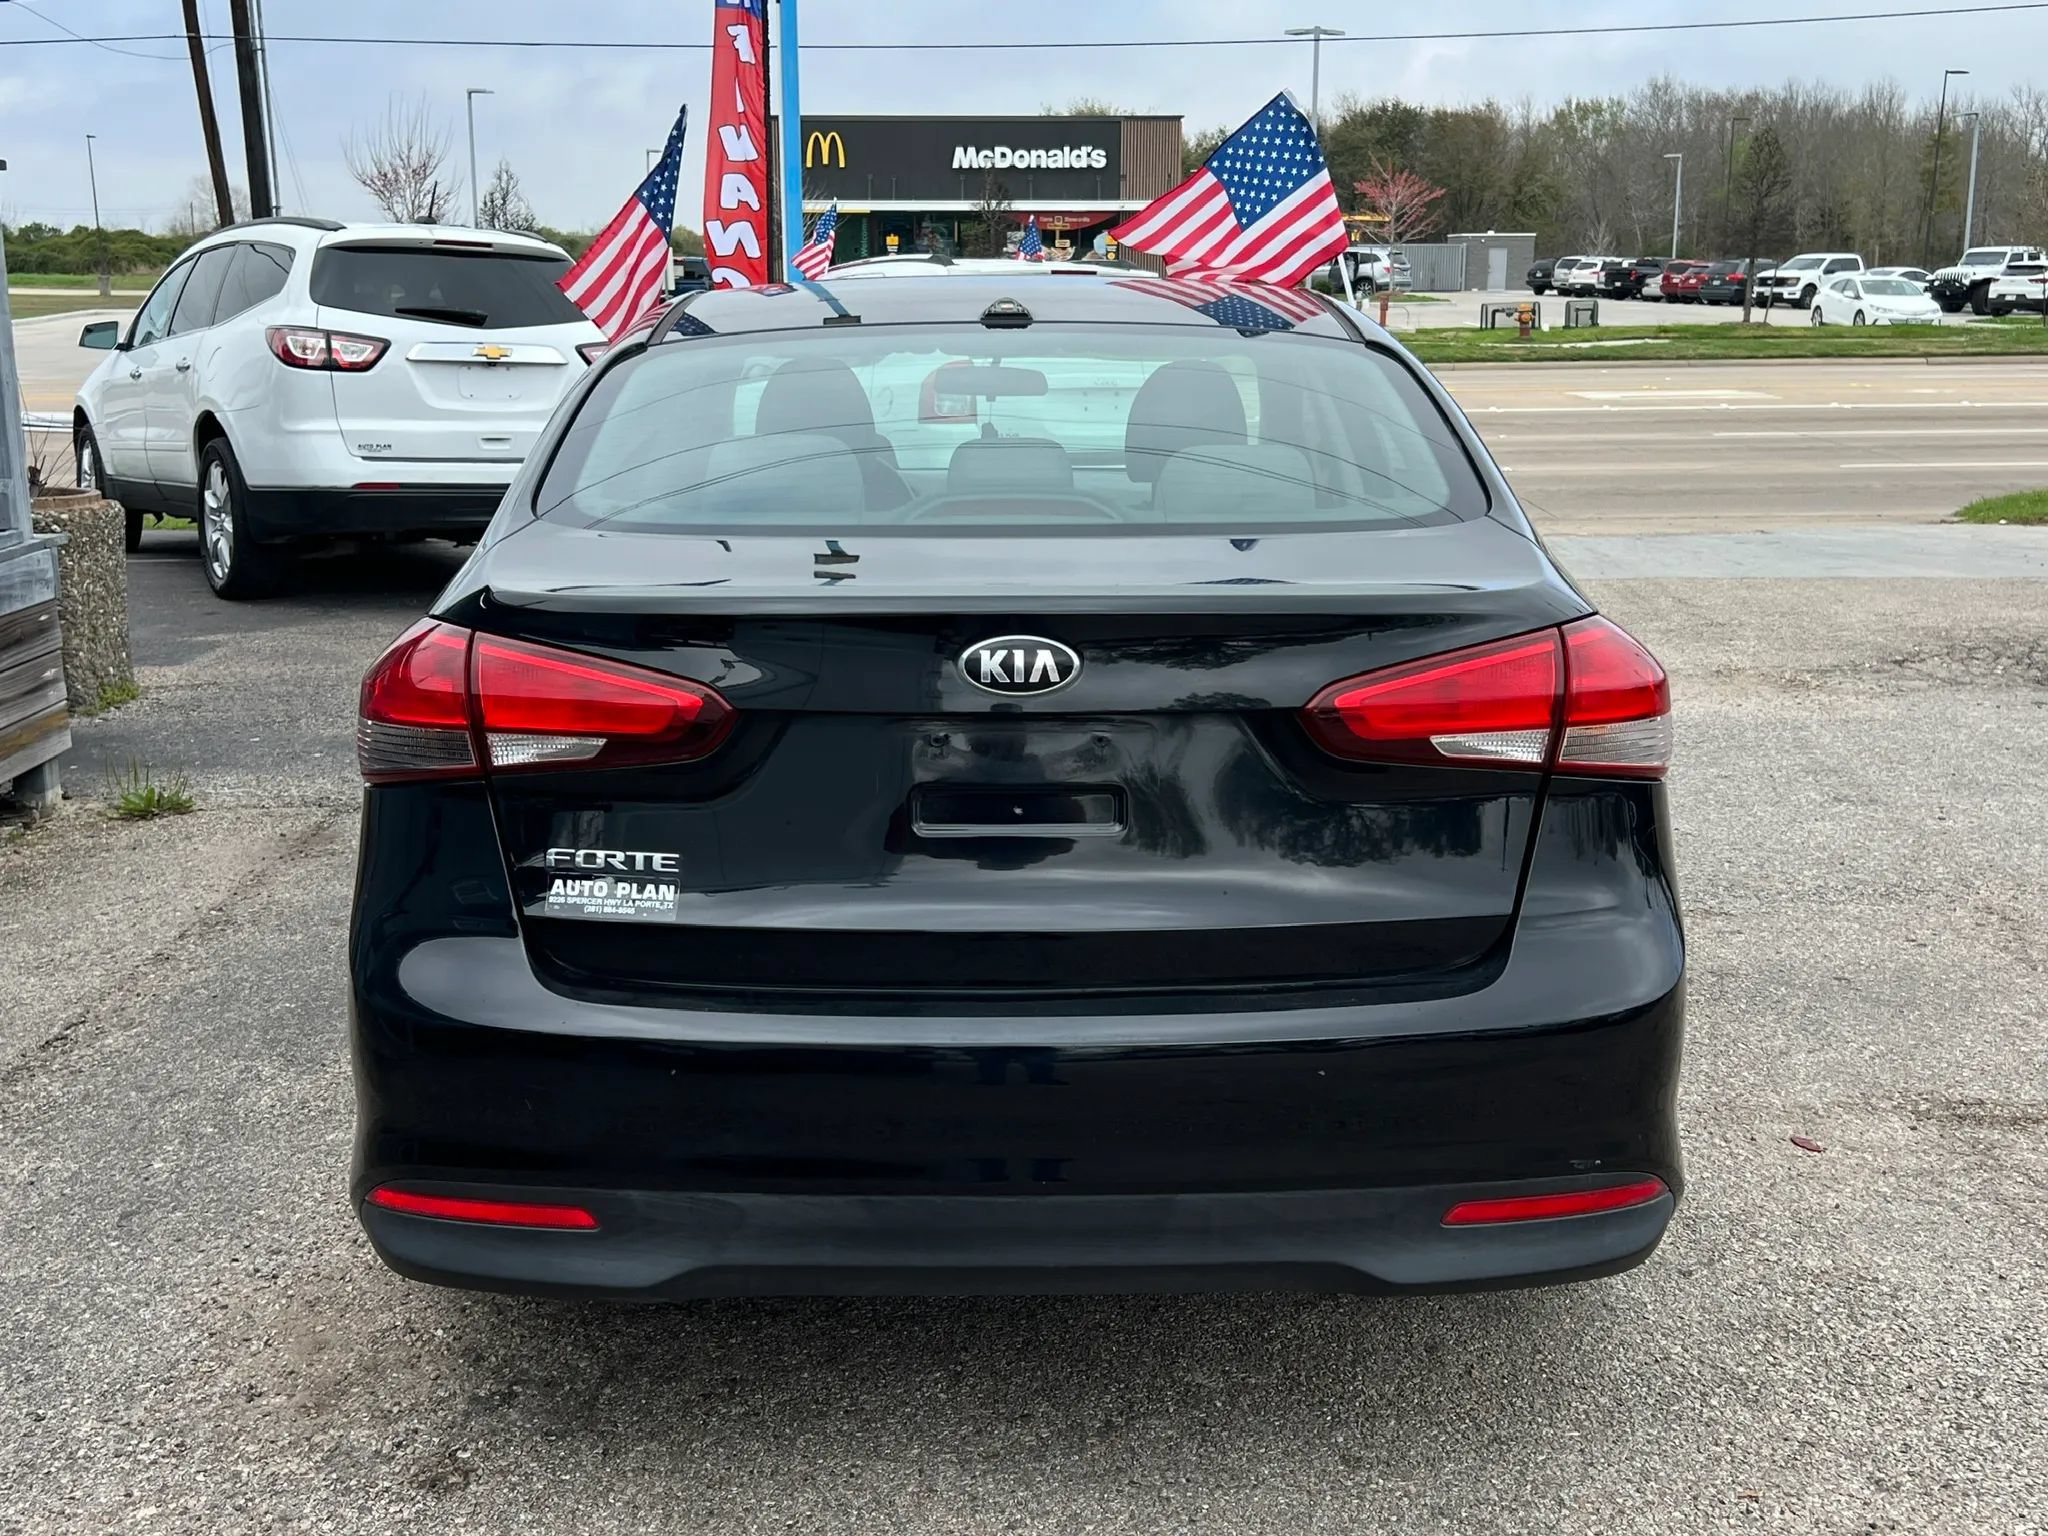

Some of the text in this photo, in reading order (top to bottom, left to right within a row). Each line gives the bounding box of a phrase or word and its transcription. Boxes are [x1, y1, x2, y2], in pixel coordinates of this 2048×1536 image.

[952, 146, 1107, 169] McDonald's
[979, 649, 1061, 683] KIA
[546, 848, 680, 872] FORTE
[550, 878, 675, 901] AUTO PLAN
[567, 897, 602, 905] SPENCER
[604, 898, 622, 906] HWY
[623, 899, 634, 907] LA
